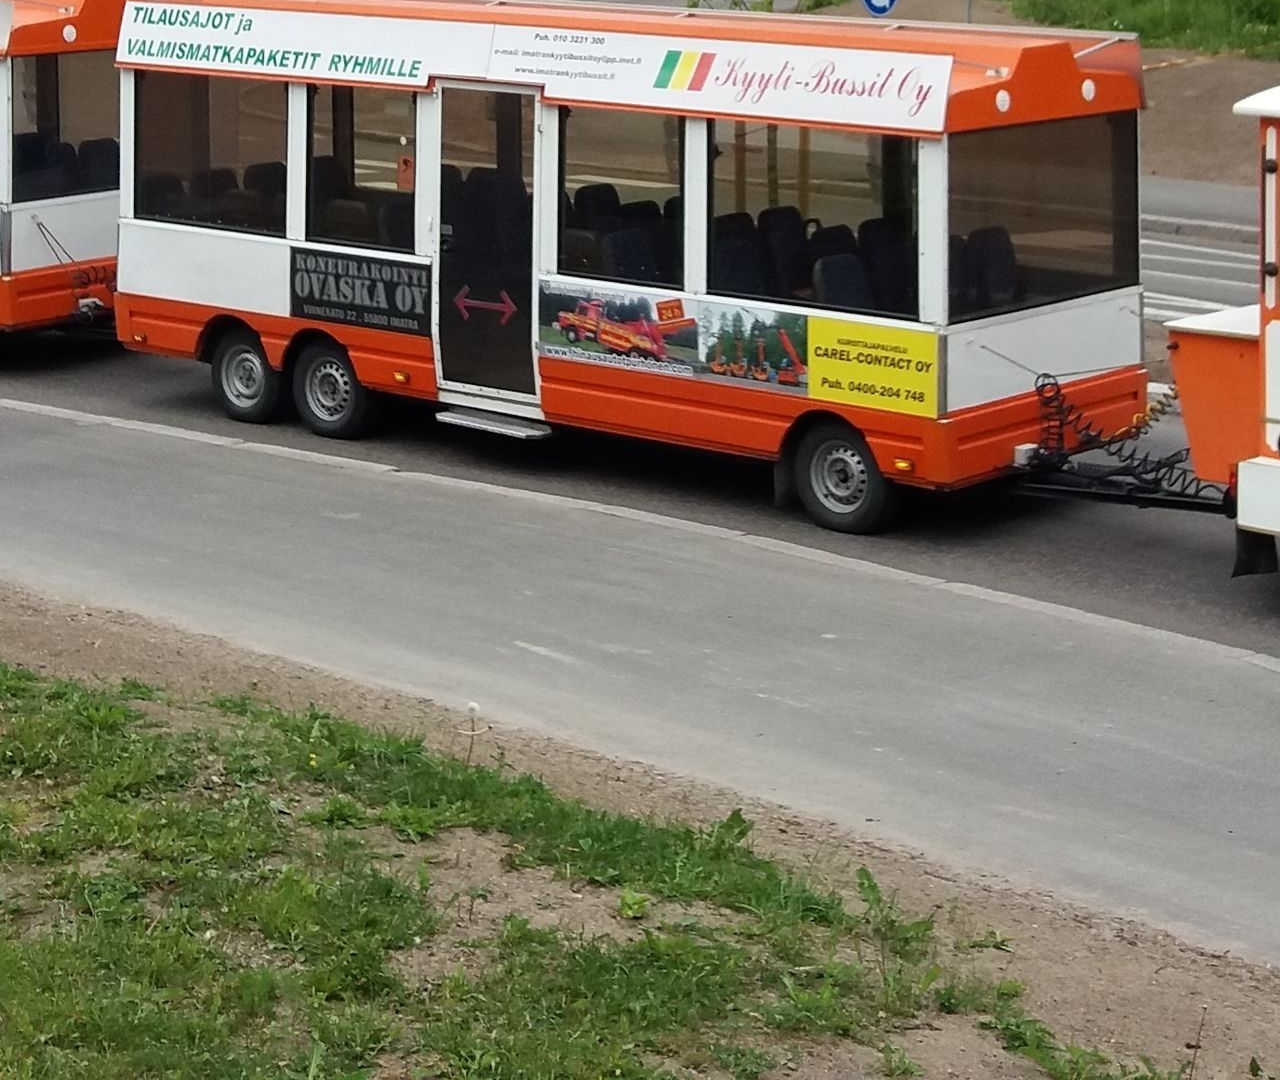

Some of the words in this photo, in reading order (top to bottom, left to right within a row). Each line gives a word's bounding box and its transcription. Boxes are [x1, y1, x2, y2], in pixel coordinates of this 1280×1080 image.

[132, 6, 235, 31] TILAUSAJOT
[235, 14, 253, 35] ja
[534, 33, 550, 42] Puh.
[553, 34, 566, 43] 010
[569, 35, 588, 44] 3231
[590, 37, 605, 45] 300
[126, 38, 321, 70] VALMISMATKAPAKETIT
[328, 54, 422, 78] RYHMILLE
[715, 58, 894, 104] Kyyti-Bussit
[897, 66, 933, 117] Oy
[295, 252, 428, 287] KONEURAKOINTI
[294, 270, 389, 309] OVASKA
[395, 284, 428, 314] OY
[814, 346, 912, 370] CAREL-CONTACT
[915, 360, 933, 373] OY
[821, 376, 845, 390] Puh.
[848, 381, 901, 398] 0400-204
[904, 390, 925, 402] 748
